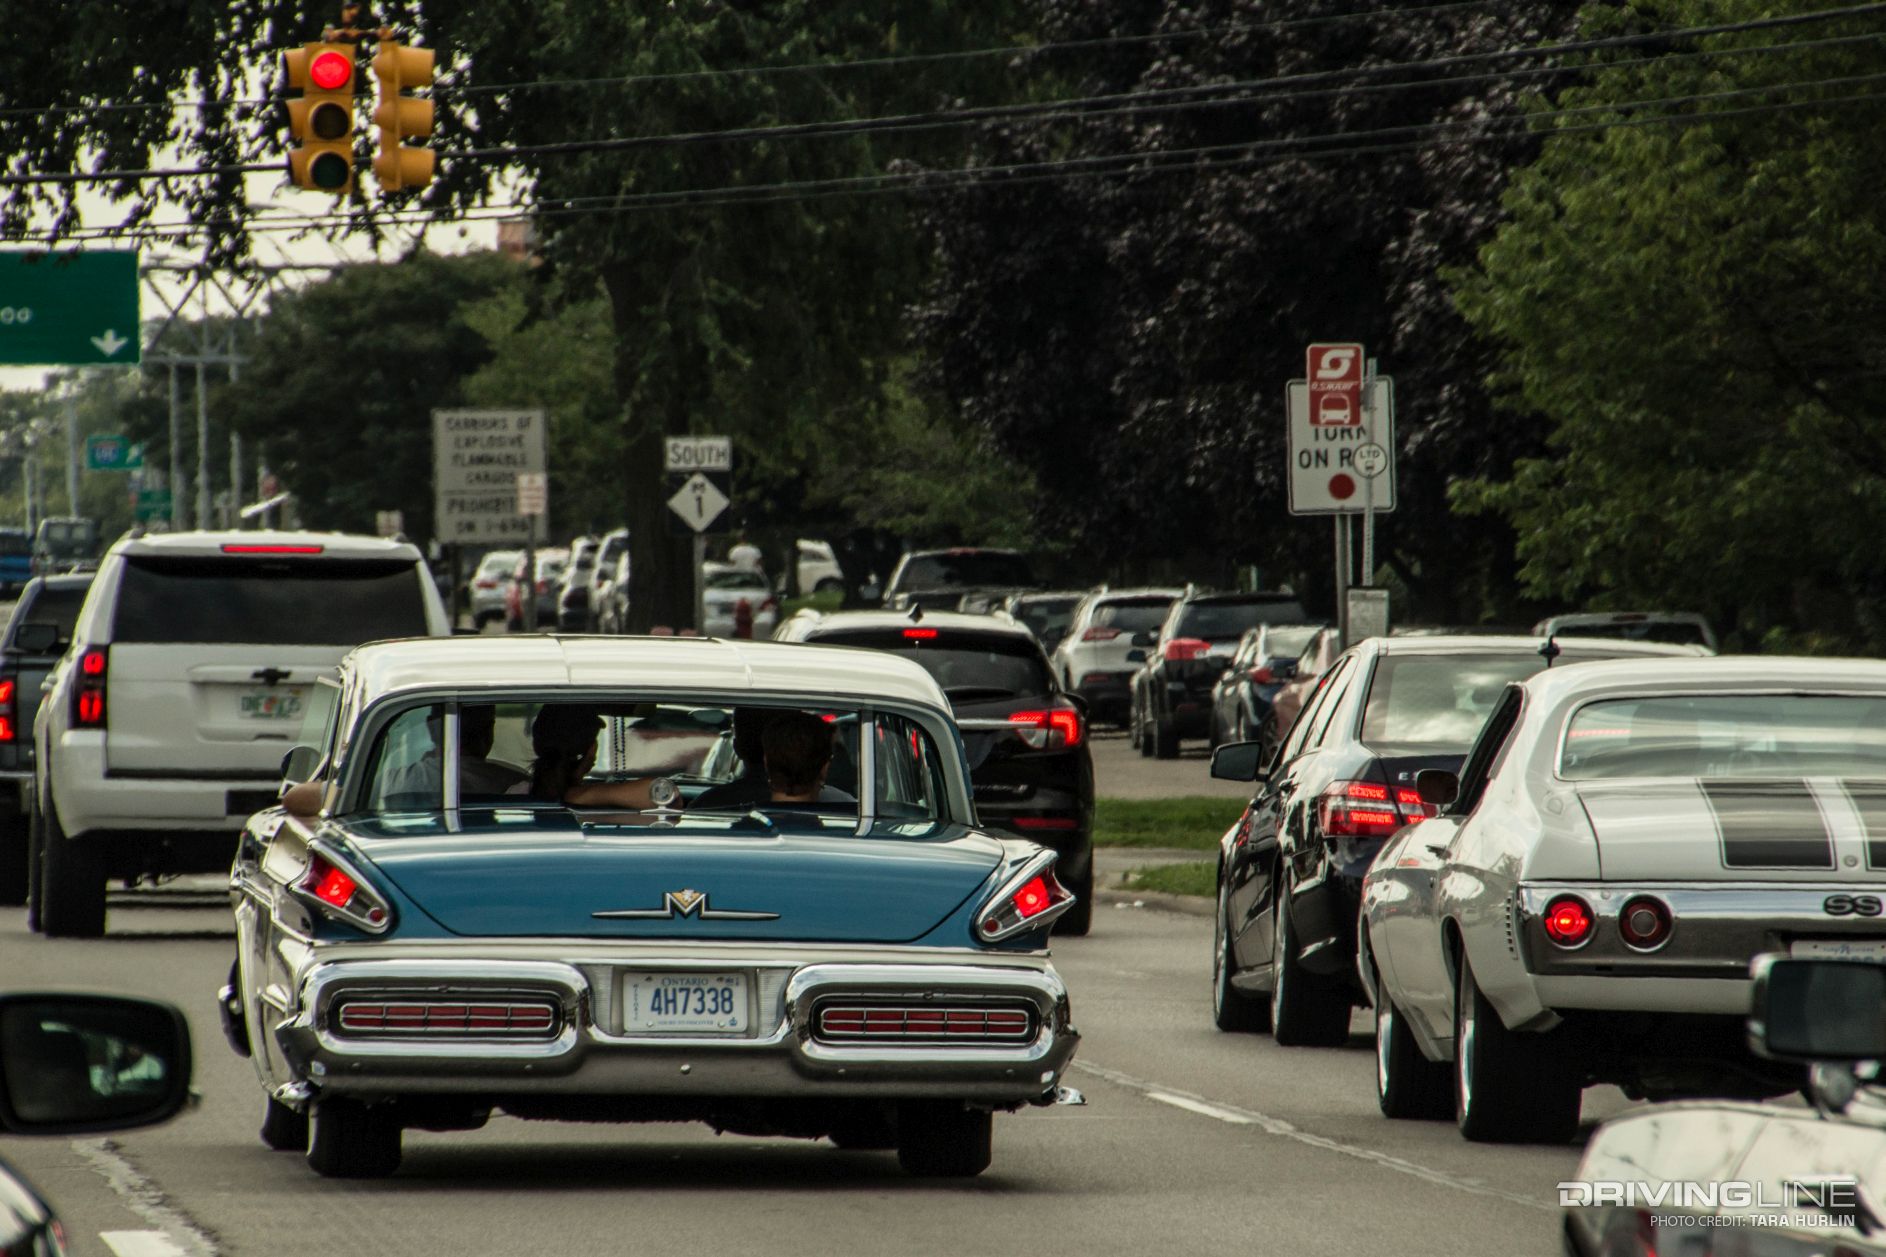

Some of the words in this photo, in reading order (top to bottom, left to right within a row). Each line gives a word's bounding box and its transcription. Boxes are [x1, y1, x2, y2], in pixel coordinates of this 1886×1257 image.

[0, 306, 32, 325] oo
[671, 442, 728, 465] SOUTH
[1299, 448, 1329, 469] ON
[1359, 450, 1380, 459] LTD
[446, 497, 516, 514] PROHIBIT
[695, 495, 704, 518] 1
[1823, 894, 1883, 917] SS
[662, 977, 708, 987] ONTARIO
[650, 987, 734, 1016] 4H7338
